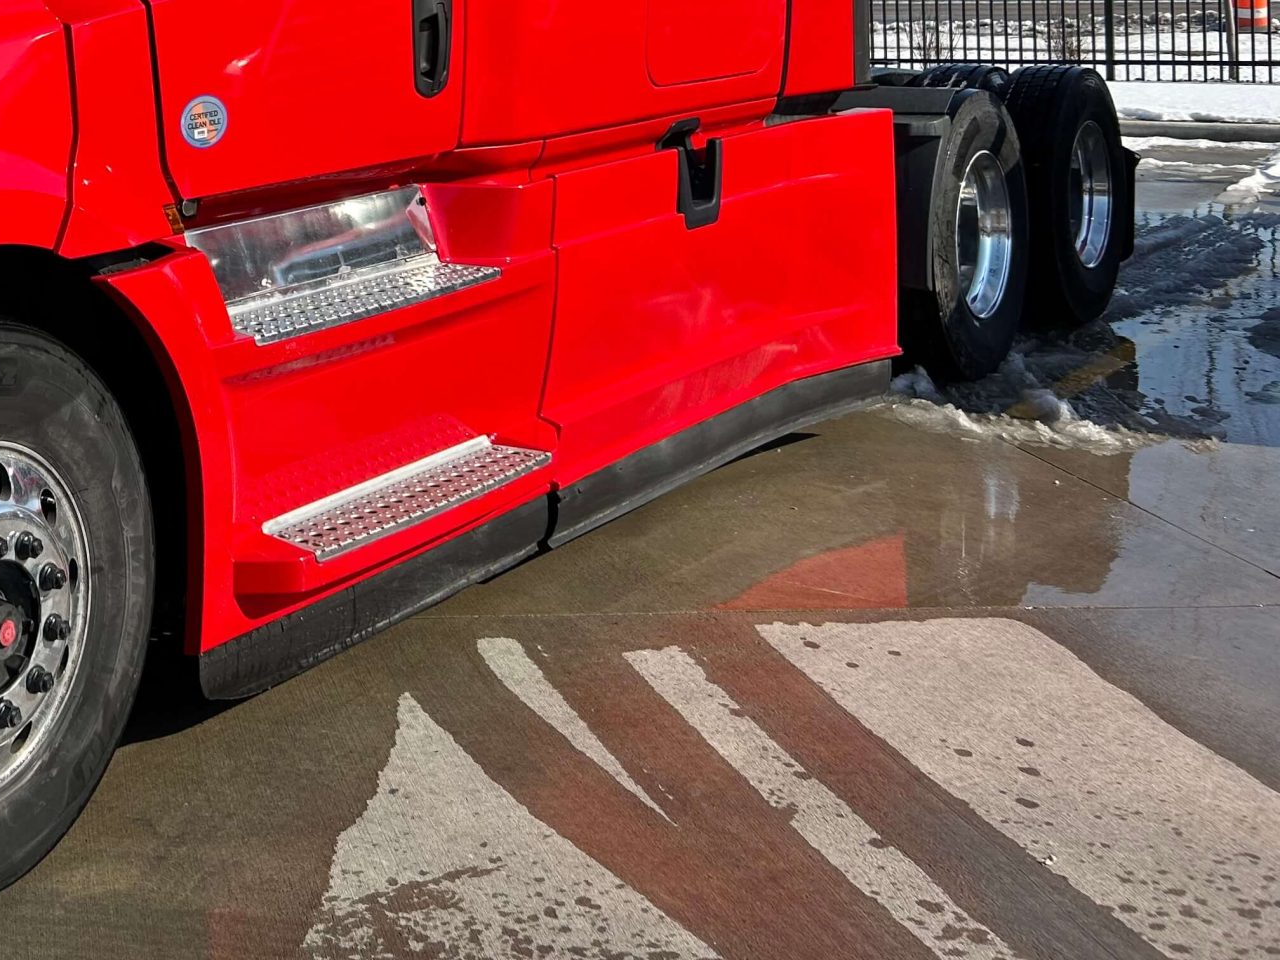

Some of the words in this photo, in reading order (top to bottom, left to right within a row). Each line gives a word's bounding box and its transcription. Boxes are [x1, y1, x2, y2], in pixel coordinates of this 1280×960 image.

[189, 110, 219, 121] CERTIFIED
[187, 120, 207, 130] CLEAN
[208, 118, 222, 127] IDLE
